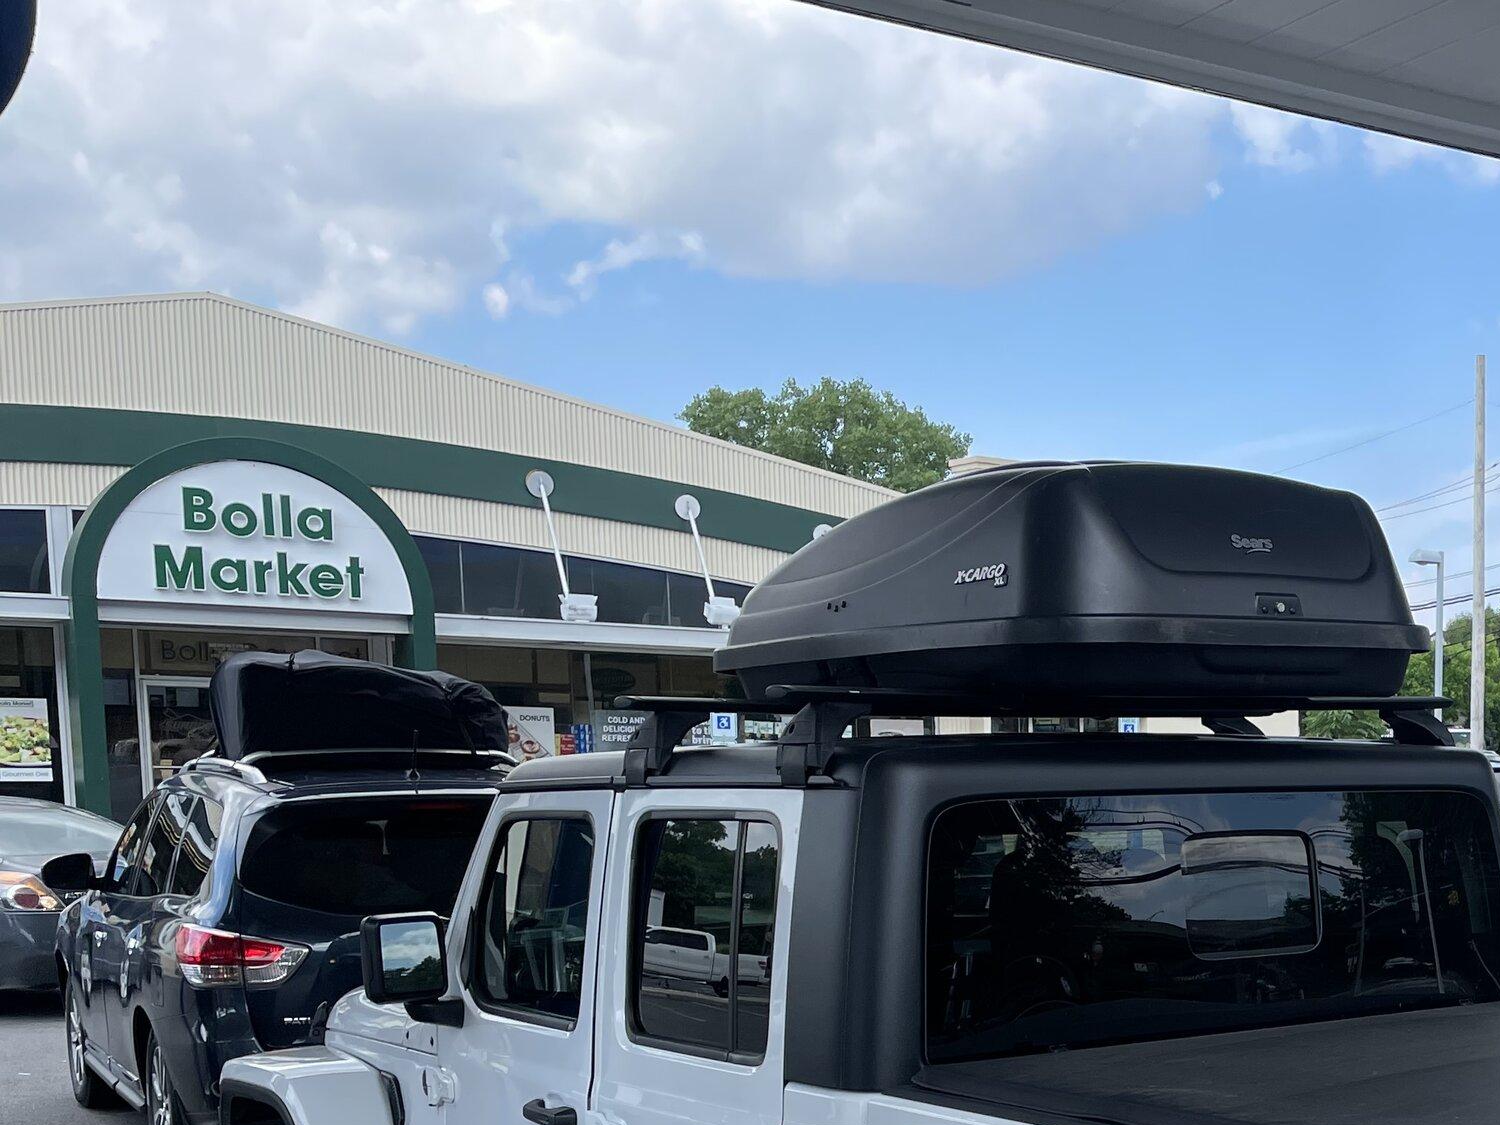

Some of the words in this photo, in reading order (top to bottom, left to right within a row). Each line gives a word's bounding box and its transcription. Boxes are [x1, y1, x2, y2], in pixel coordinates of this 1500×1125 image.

[181, 486, 334, 542] Bolla
[1231, 534, 1274, 550] Sears
[153, 543, 365, 600] Market
[994, 576, 1006, 587] XL
[519, 714, 550, 722] DONUTS
[607, 716, 628, 725] COLD
[691, 735, 711, 744] brin
